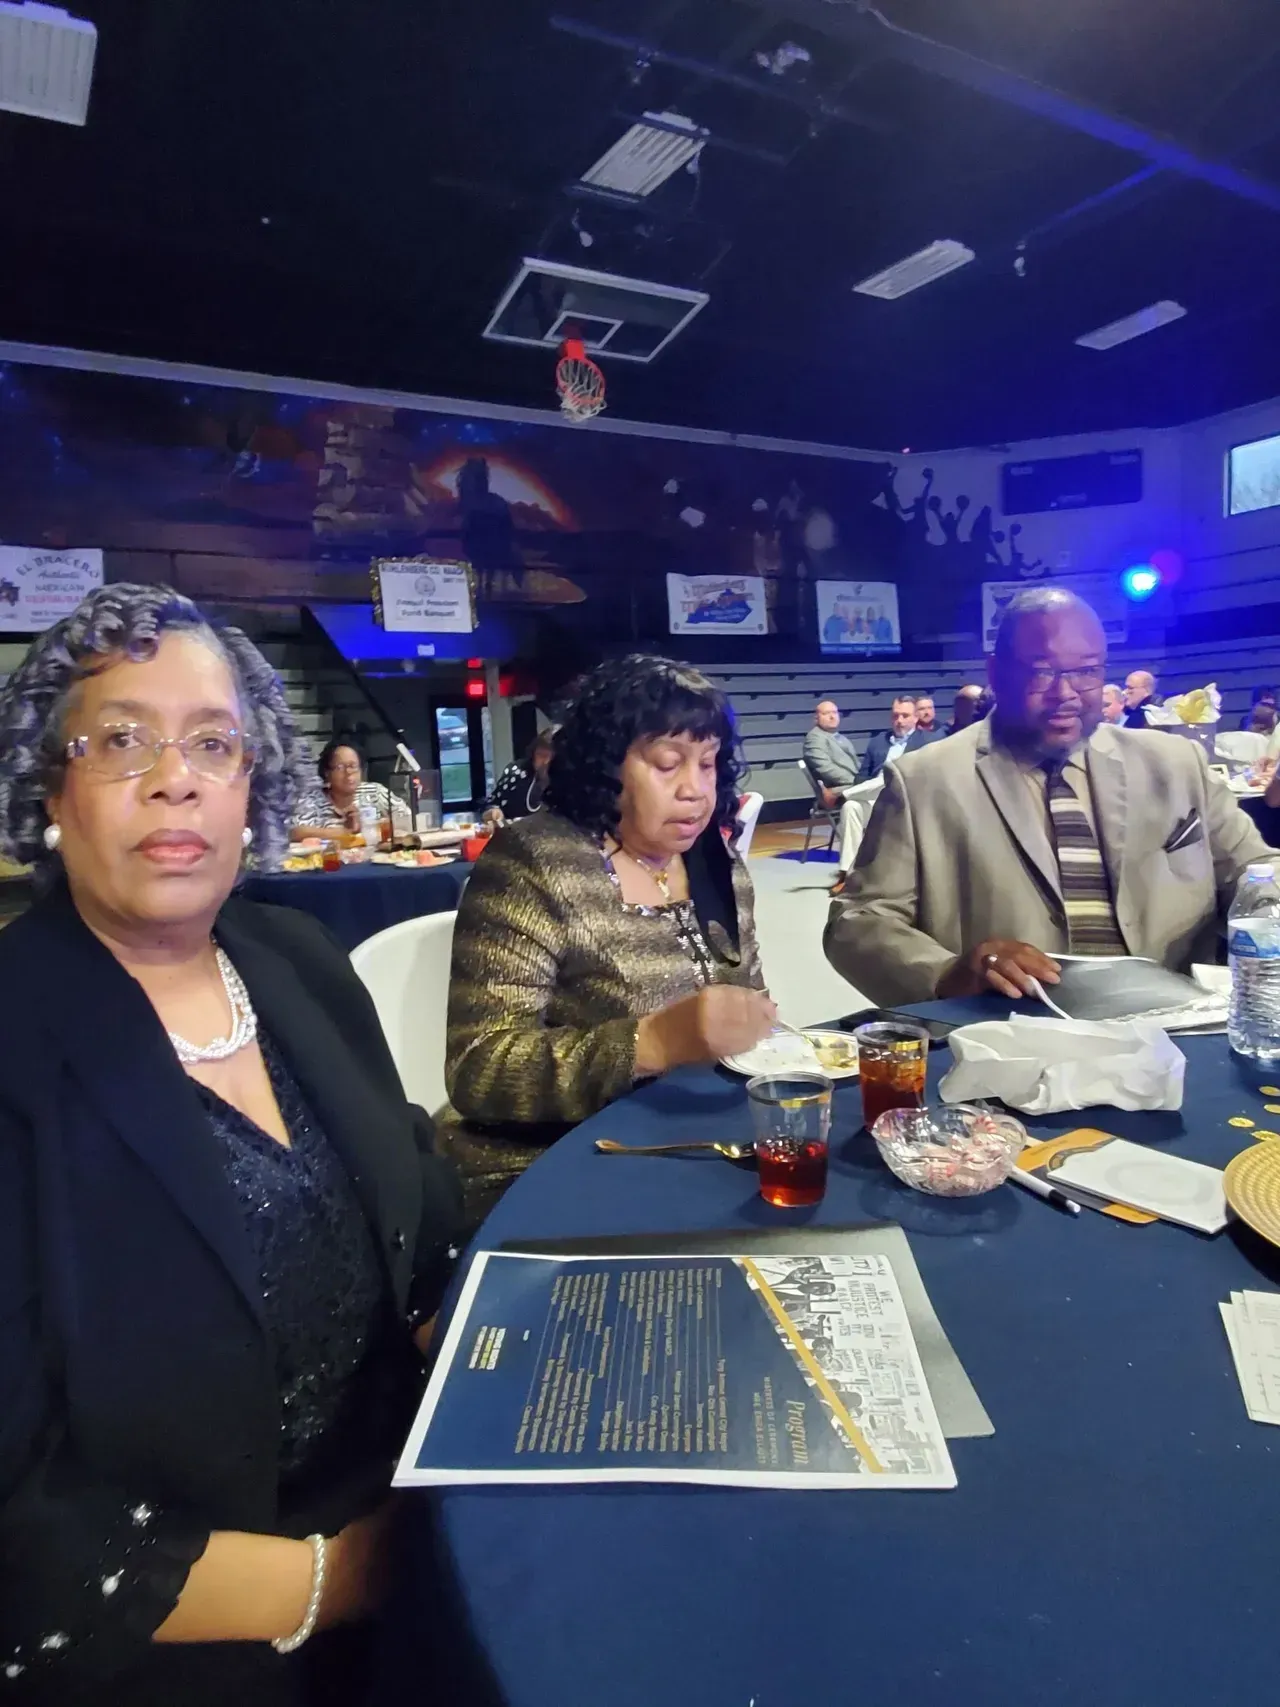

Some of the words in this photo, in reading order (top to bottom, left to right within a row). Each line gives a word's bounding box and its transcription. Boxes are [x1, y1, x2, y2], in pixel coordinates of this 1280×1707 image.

[16, 564, 32, 576] EL
[846, 1280, 869, 1319] INJUSTICE
[862, 1282, 883, 1315] PROTEST
[878, 1290, 894, 1303] WE
[762, 1376, 774, 1408] MISTRESS
[765, 1411, 775, 1420] OF
[784, 1400, 810, 1464] Program
